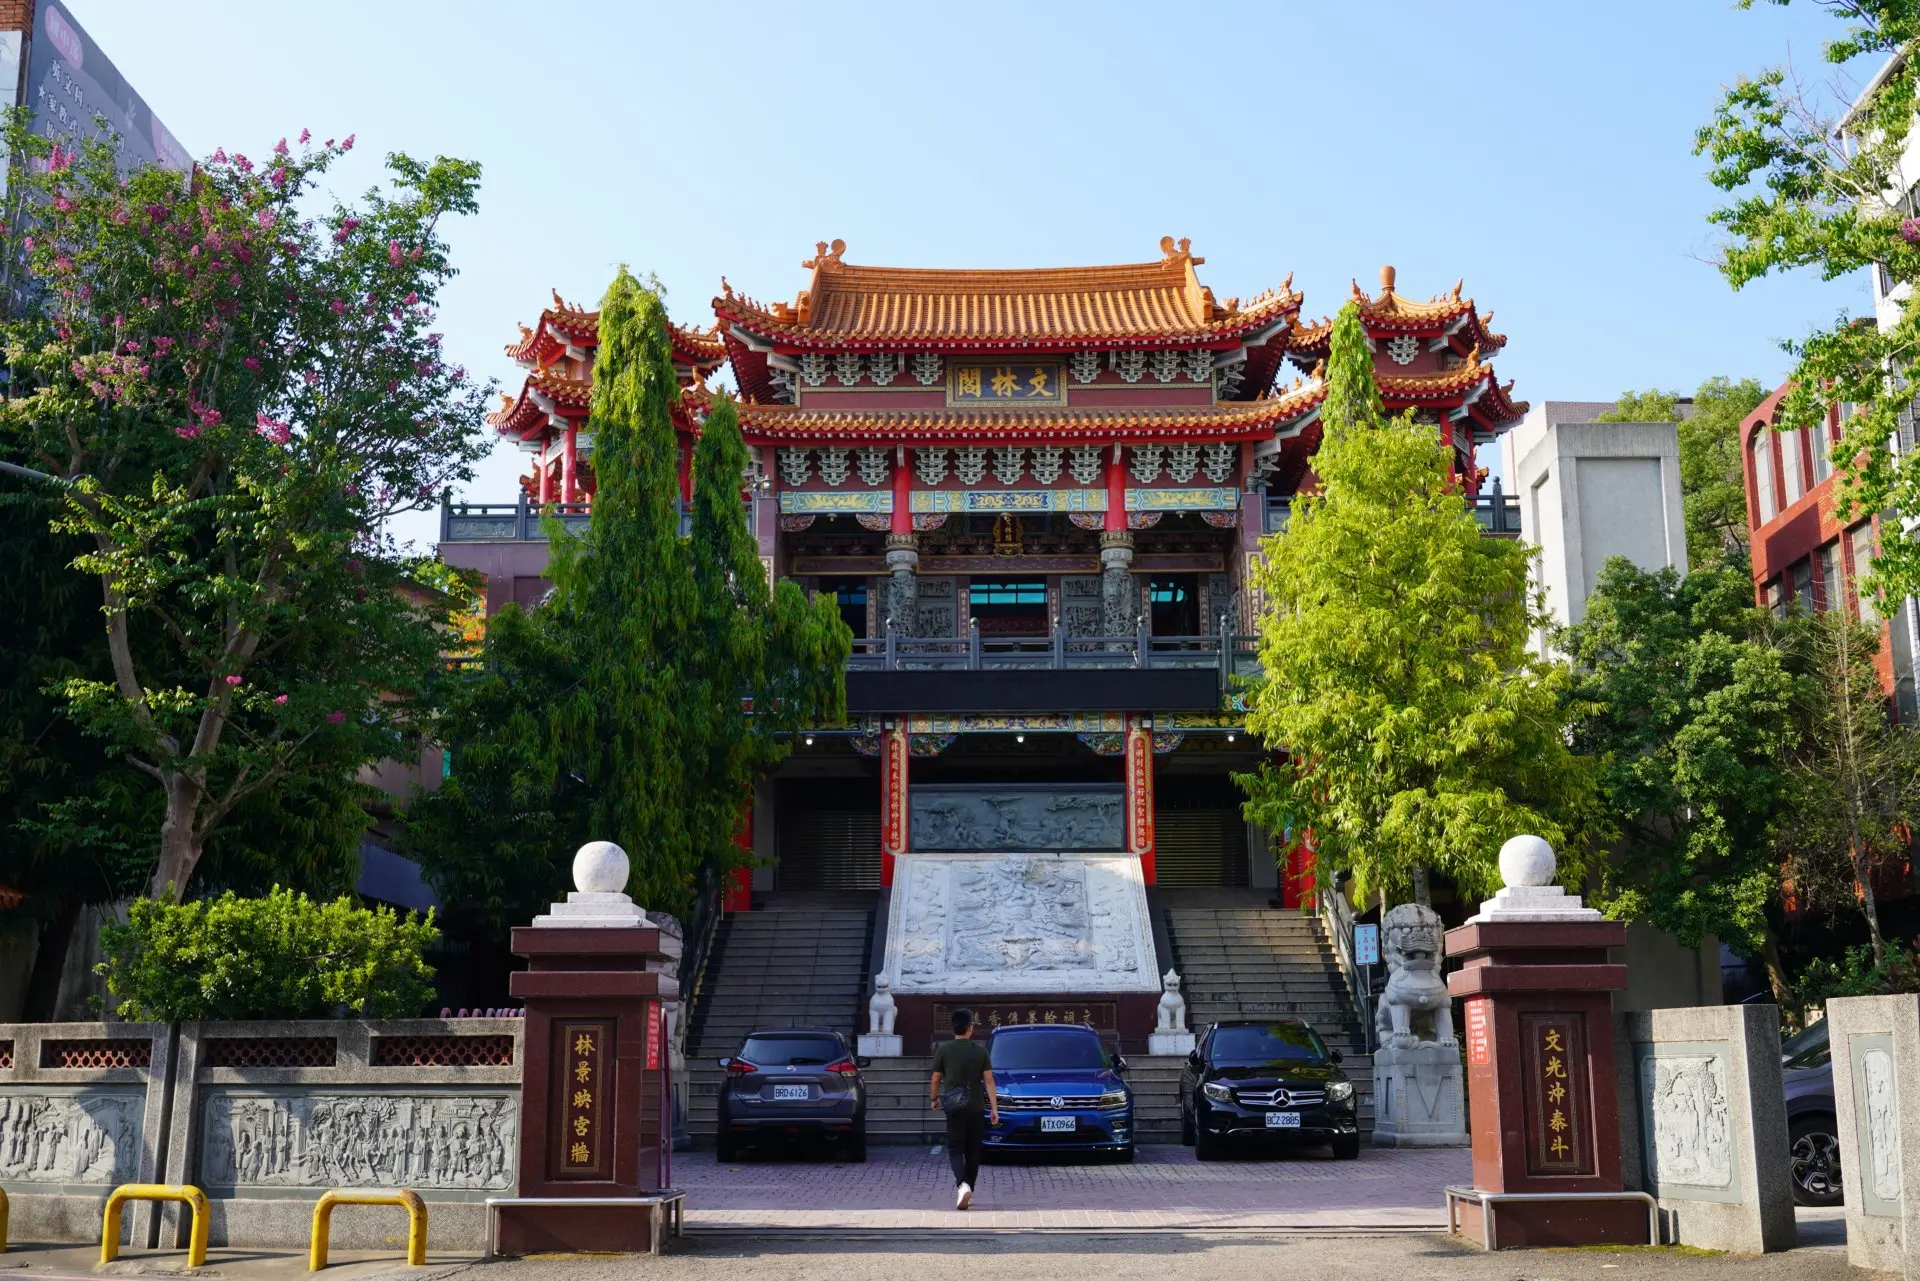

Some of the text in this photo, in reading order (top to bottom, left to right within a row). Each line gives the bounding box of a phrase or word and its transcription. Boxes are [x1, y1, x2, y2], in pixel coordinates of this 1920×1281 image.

[958, 367, 1054, 398] 文林閣
[1042, 1119, 1075, 1129] ATX-0966
[1266, 1116, 1299, 1125] BCZ-2885
